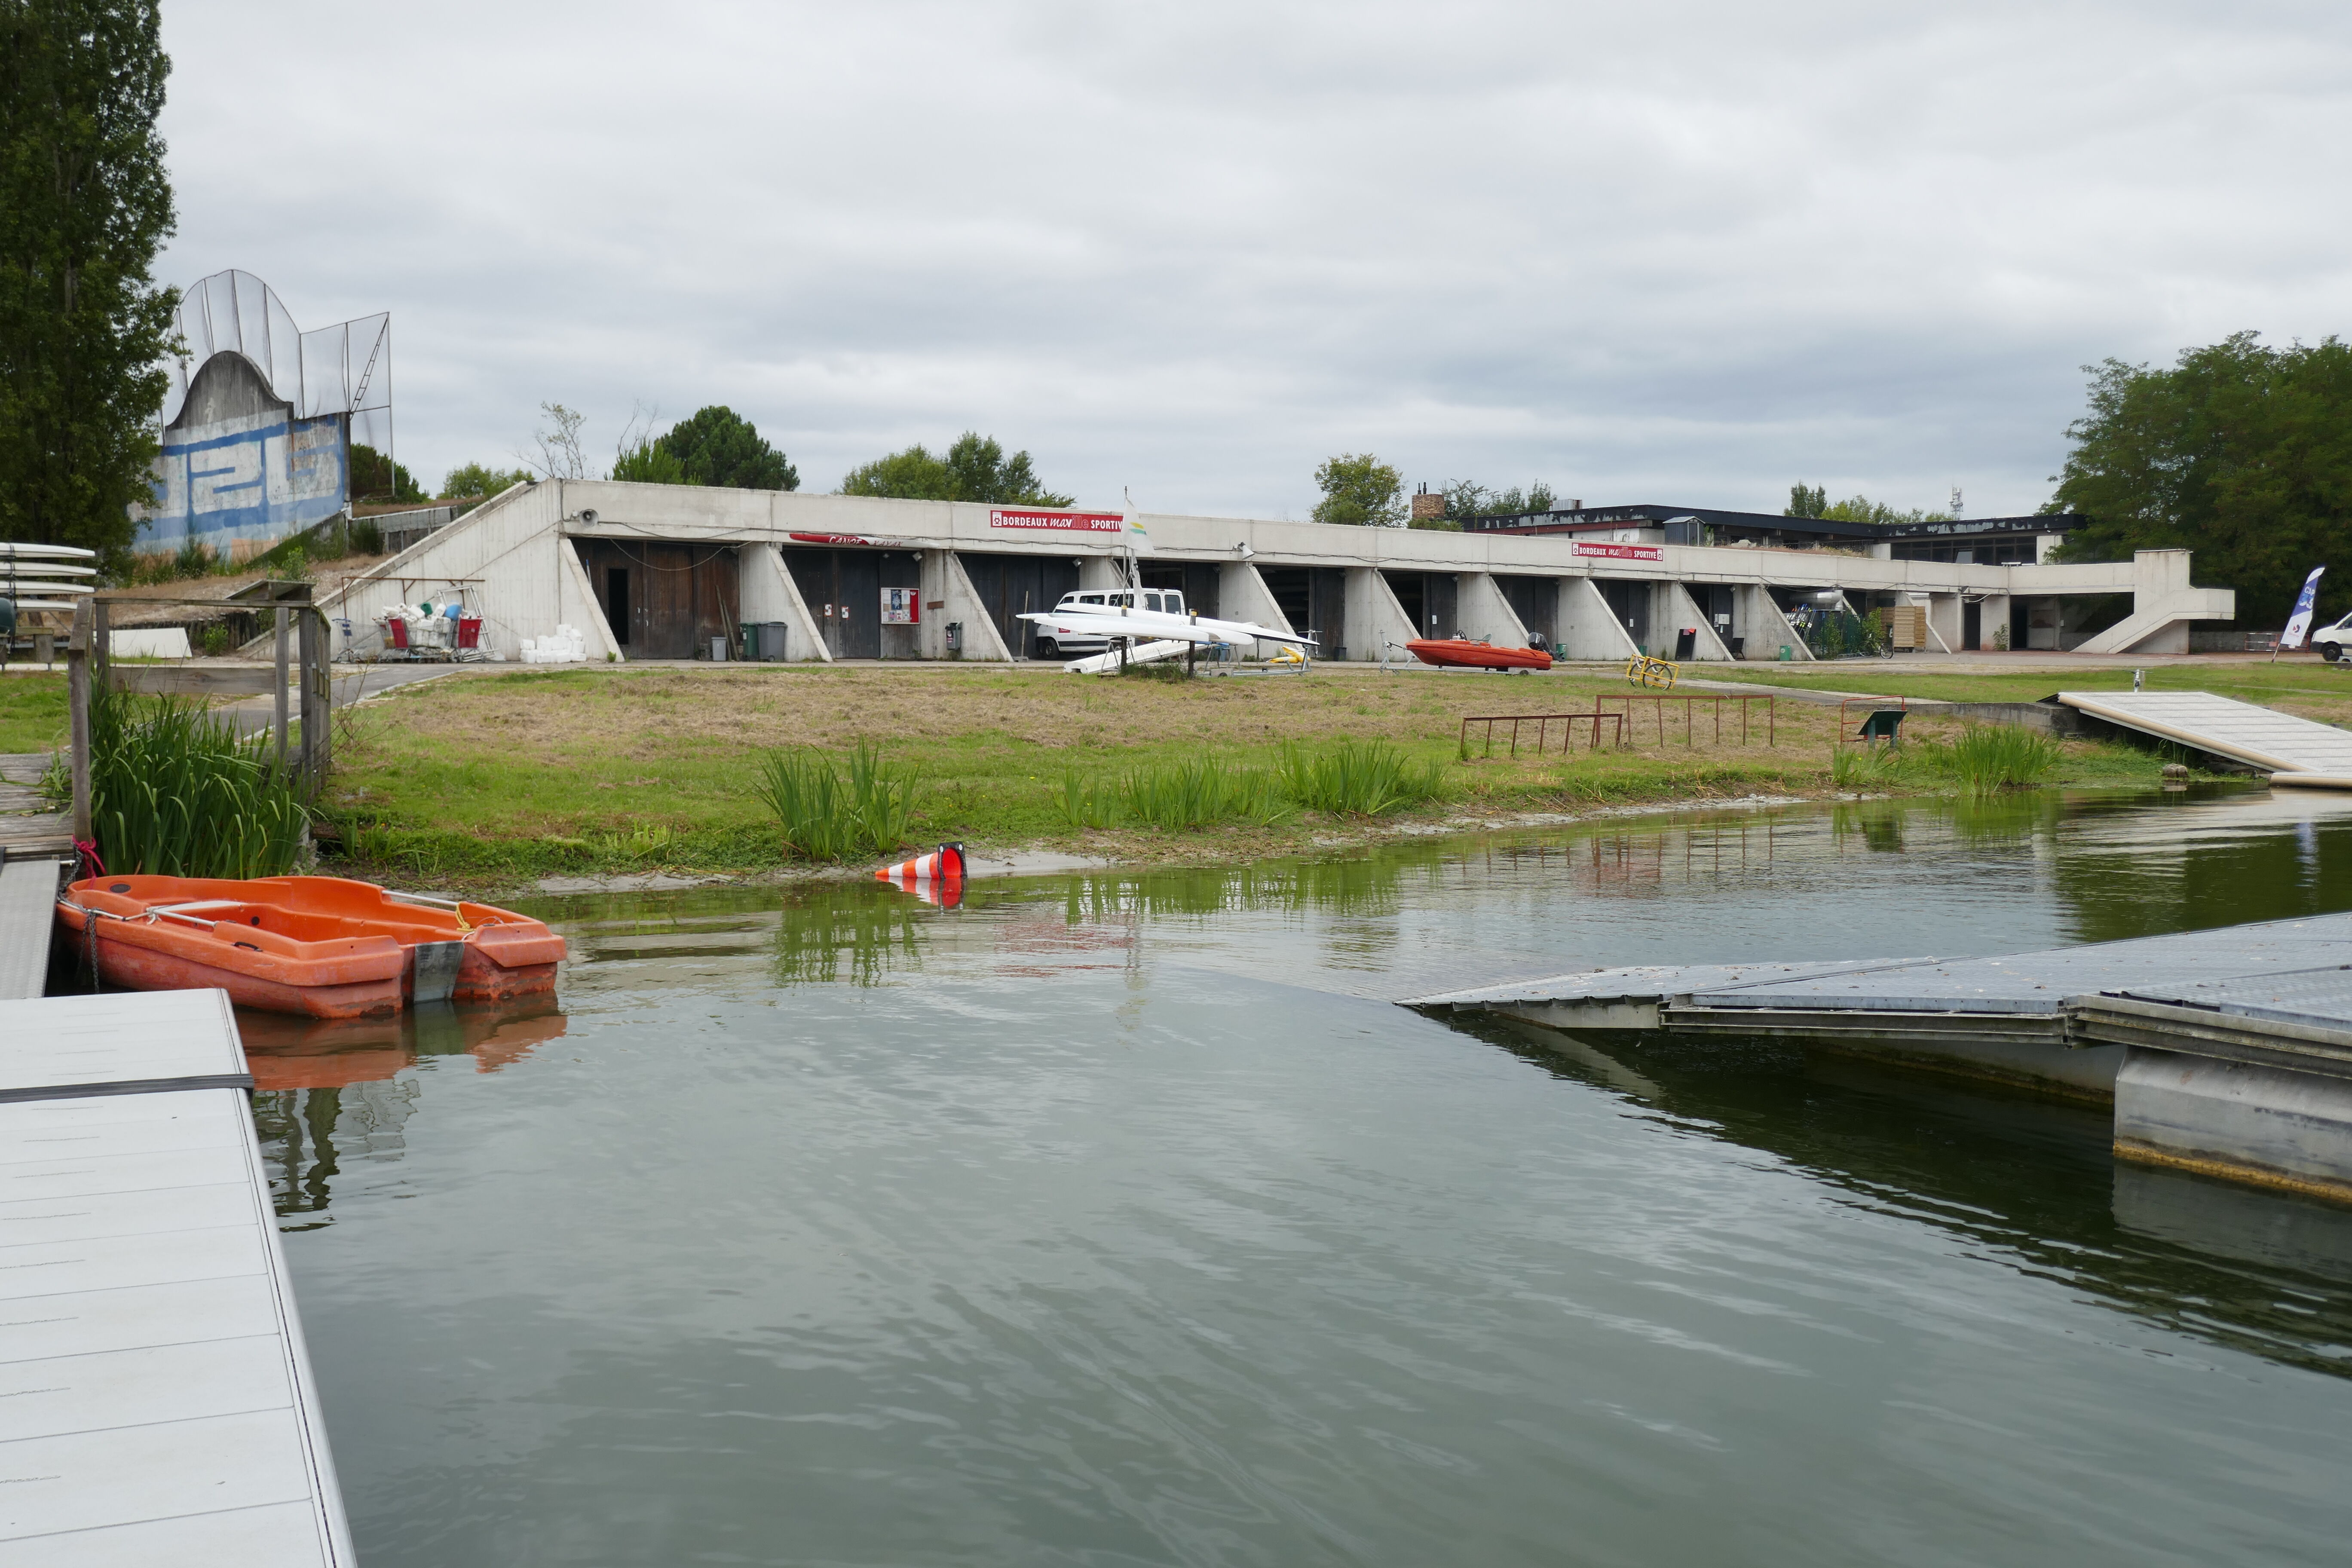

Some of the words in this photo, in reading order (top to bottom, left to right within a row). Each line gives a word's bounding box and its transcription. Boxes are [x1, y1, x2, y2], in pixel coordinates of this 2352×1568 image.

[1003, 517, 1047, 527] BORDEAUX
[1091, 520, 1123, 530] SPORTIV
[1579, 547, 1606, 556] BORDEAUX
[1634, 550, 1657, 559] SPORTIVE
[2304, 586, 2315, 596] CAP
